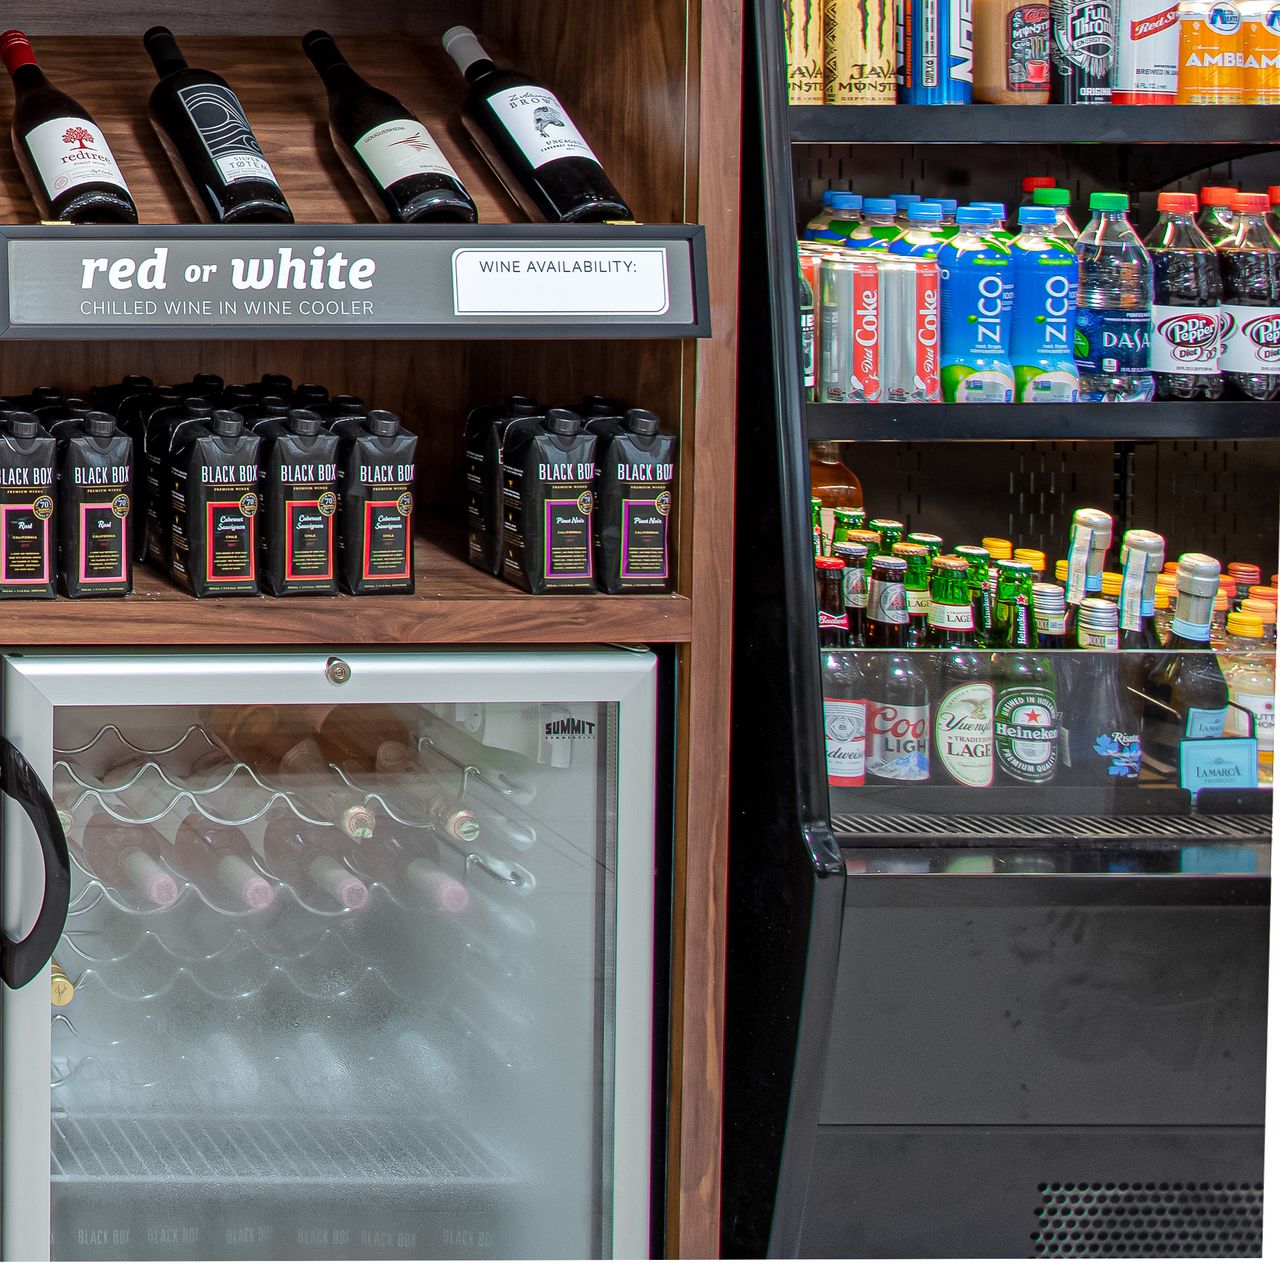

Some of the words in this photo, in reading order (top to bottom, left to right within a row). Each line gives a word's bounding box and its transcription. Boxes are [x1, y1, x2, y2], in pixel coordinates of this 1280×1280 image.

[1135, 19, 1165, 36] Red
[850, 59, 896, 80] JAVA
[60, 150, 112, 165] redtree
[81, 248, 168, 290] red
[184, 263, 217, 284] or
[230, 245, 377, 290] white
[479, 260, 521, 273] WINE
[526, 260, 638, 273] AVAILABILITY:
[80, 301, 157, 315] CHILLED
[164, 301, 212, 315] WINE
[219, 301, 237, 315] IN
[244, 301, 292, 315] WINE
[299, 300, 374, 315] COOLER
[977, 276, 1003, 343] ZICO
[1045, 275, 1069, 342] ZICO
[855, 289, 878, 346] Coke
[918, 289, 938, 346] Coke
[1189, 318, 1206, 331] Dr
[1174, 322, 1214, 344] Pepper
[861, 348, 874, 373] Diet
[924, 348, 935, 373] Diet
[1179, 349, 1198, 359] Diet
[33, 467, 53, 485] BOX
[75, 466, 108, 484] BLACK
[112, 466, 130, 483] BOX
[201, 465, 236, 483] BLACK
[239, 465, 258, 482] BOX
[280, 465, 314, 482] BLACK
[318, 463, 336, 481] BOX
[360, 465, 394, 483] BLACK
[397, 464, 415, 481] BOX
[538, 463, 574, 480] BLACK
[577, 463, 595, 480] BOX
[617, 463, 653, 481] BLACK
[656, 463, 674, 480] BOX
[1017, 606, 1027, 644] Heineken
[1002, 697, 1025, 716] BREWED
[545, 717, 596, 735] SUMMIT
[996, 723, 1058, 740] Heineken
[1002, 748, 1035, 772] PREMIUM
